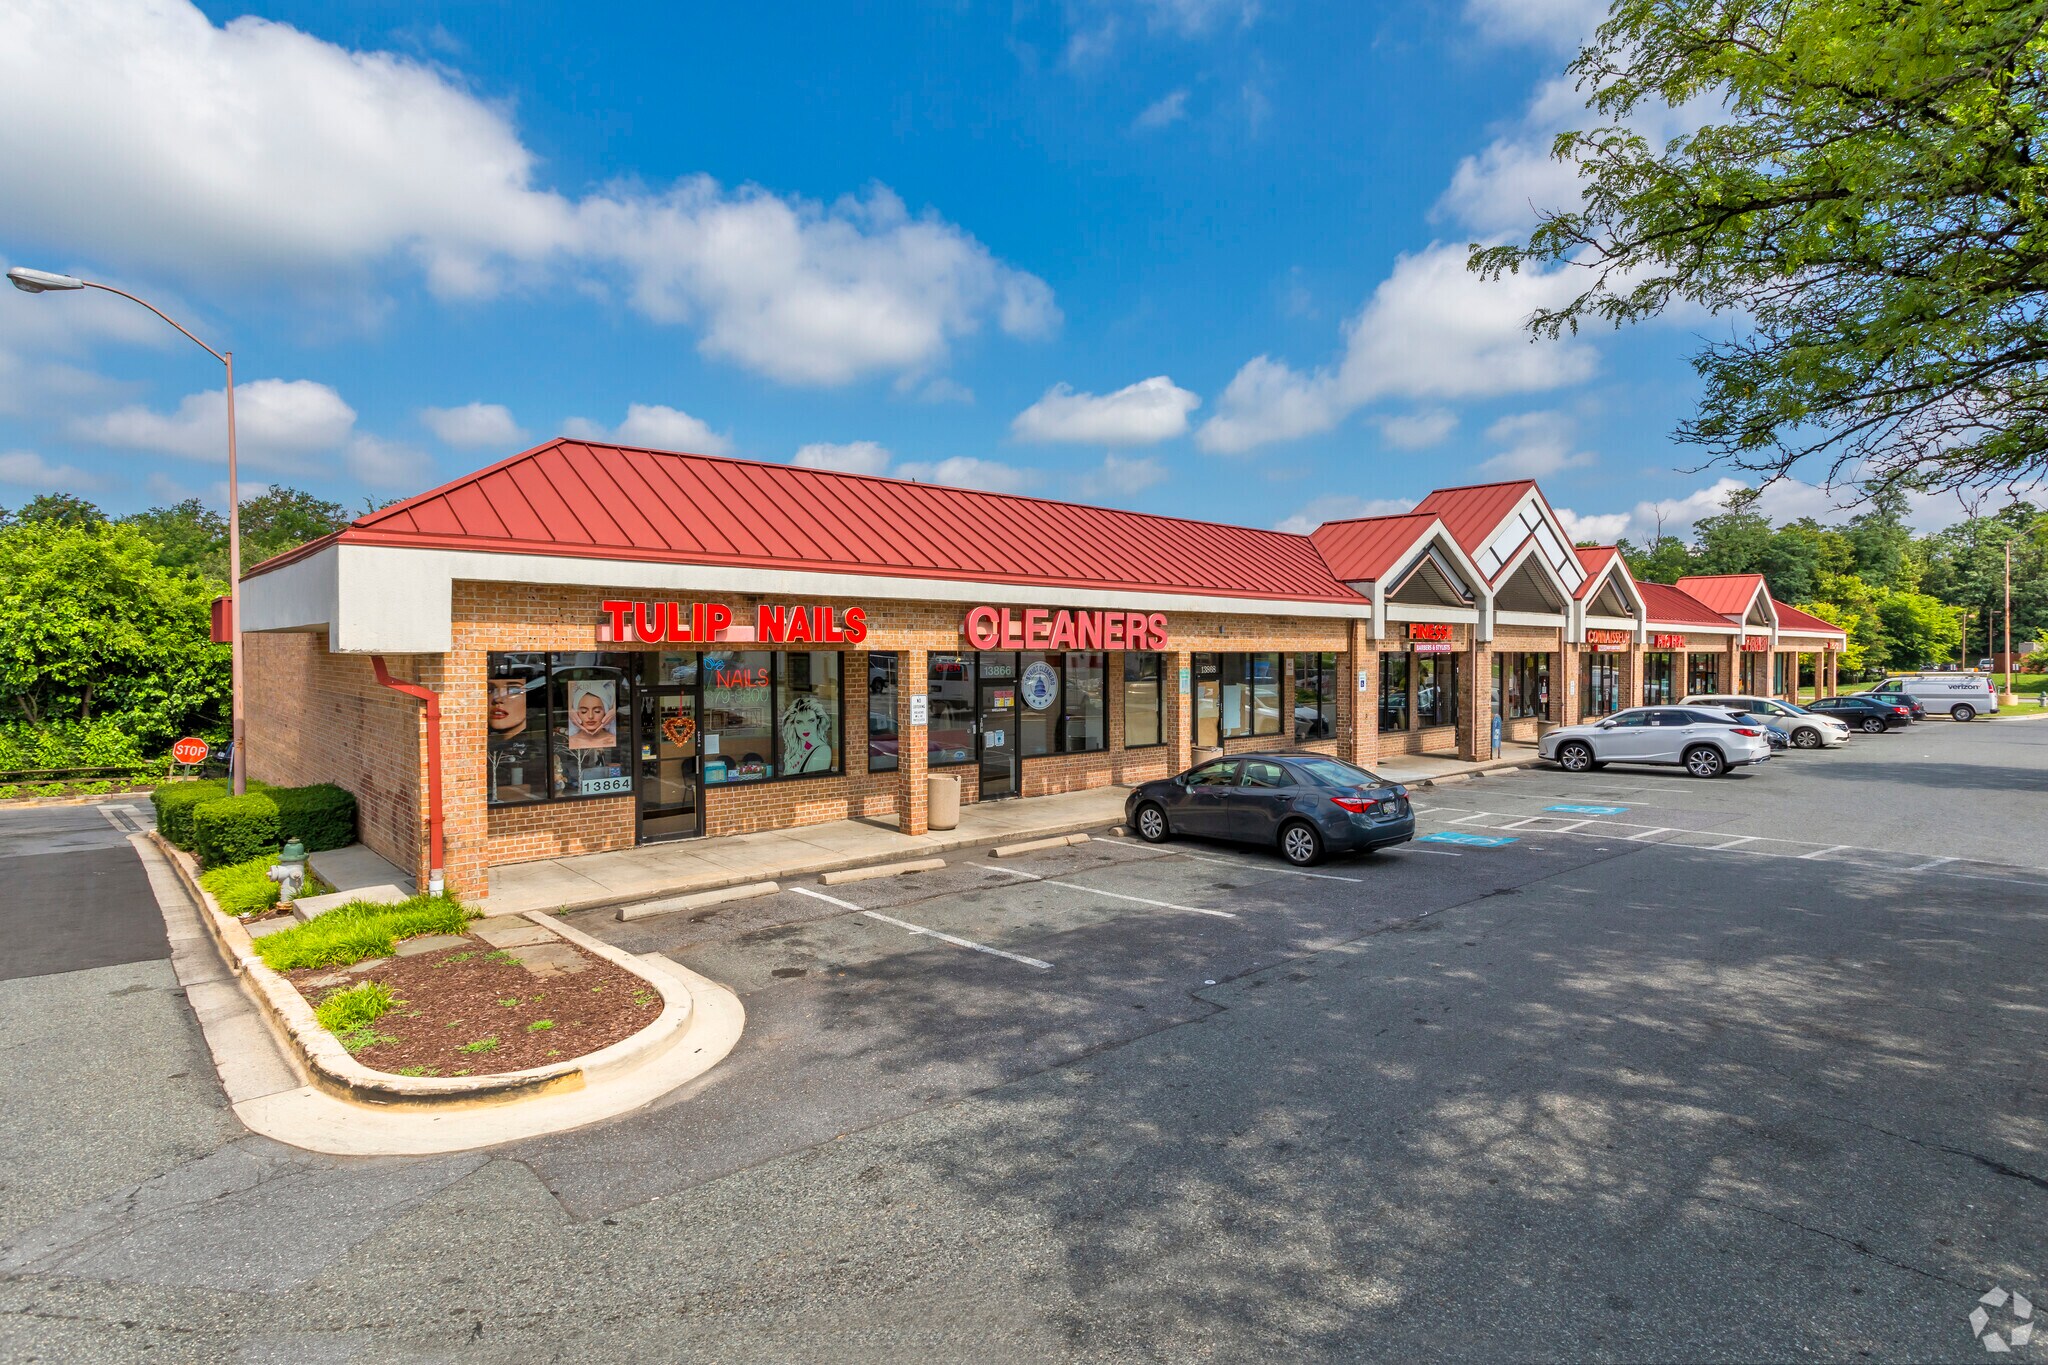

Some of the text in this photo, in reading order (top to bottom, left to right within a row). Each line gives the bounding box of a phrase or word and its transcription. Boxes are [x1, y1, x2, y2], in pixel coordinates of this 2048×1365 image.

[602, 600, 868, 644] TULIP NAILS
[964, 606, 1168, 649] CLEANERS
[1409, 623, 1453, 640] FINESSE
[936, 663, 961, 672] OPEN
[984, 665, 1012, 676] 13866
[1039, 666, 1056, 686] CLEANERS
[716, 668, 769, 688] NAILS
[176, 745, 206, 756] STOP
[584, 779, 630, 792] 13864
